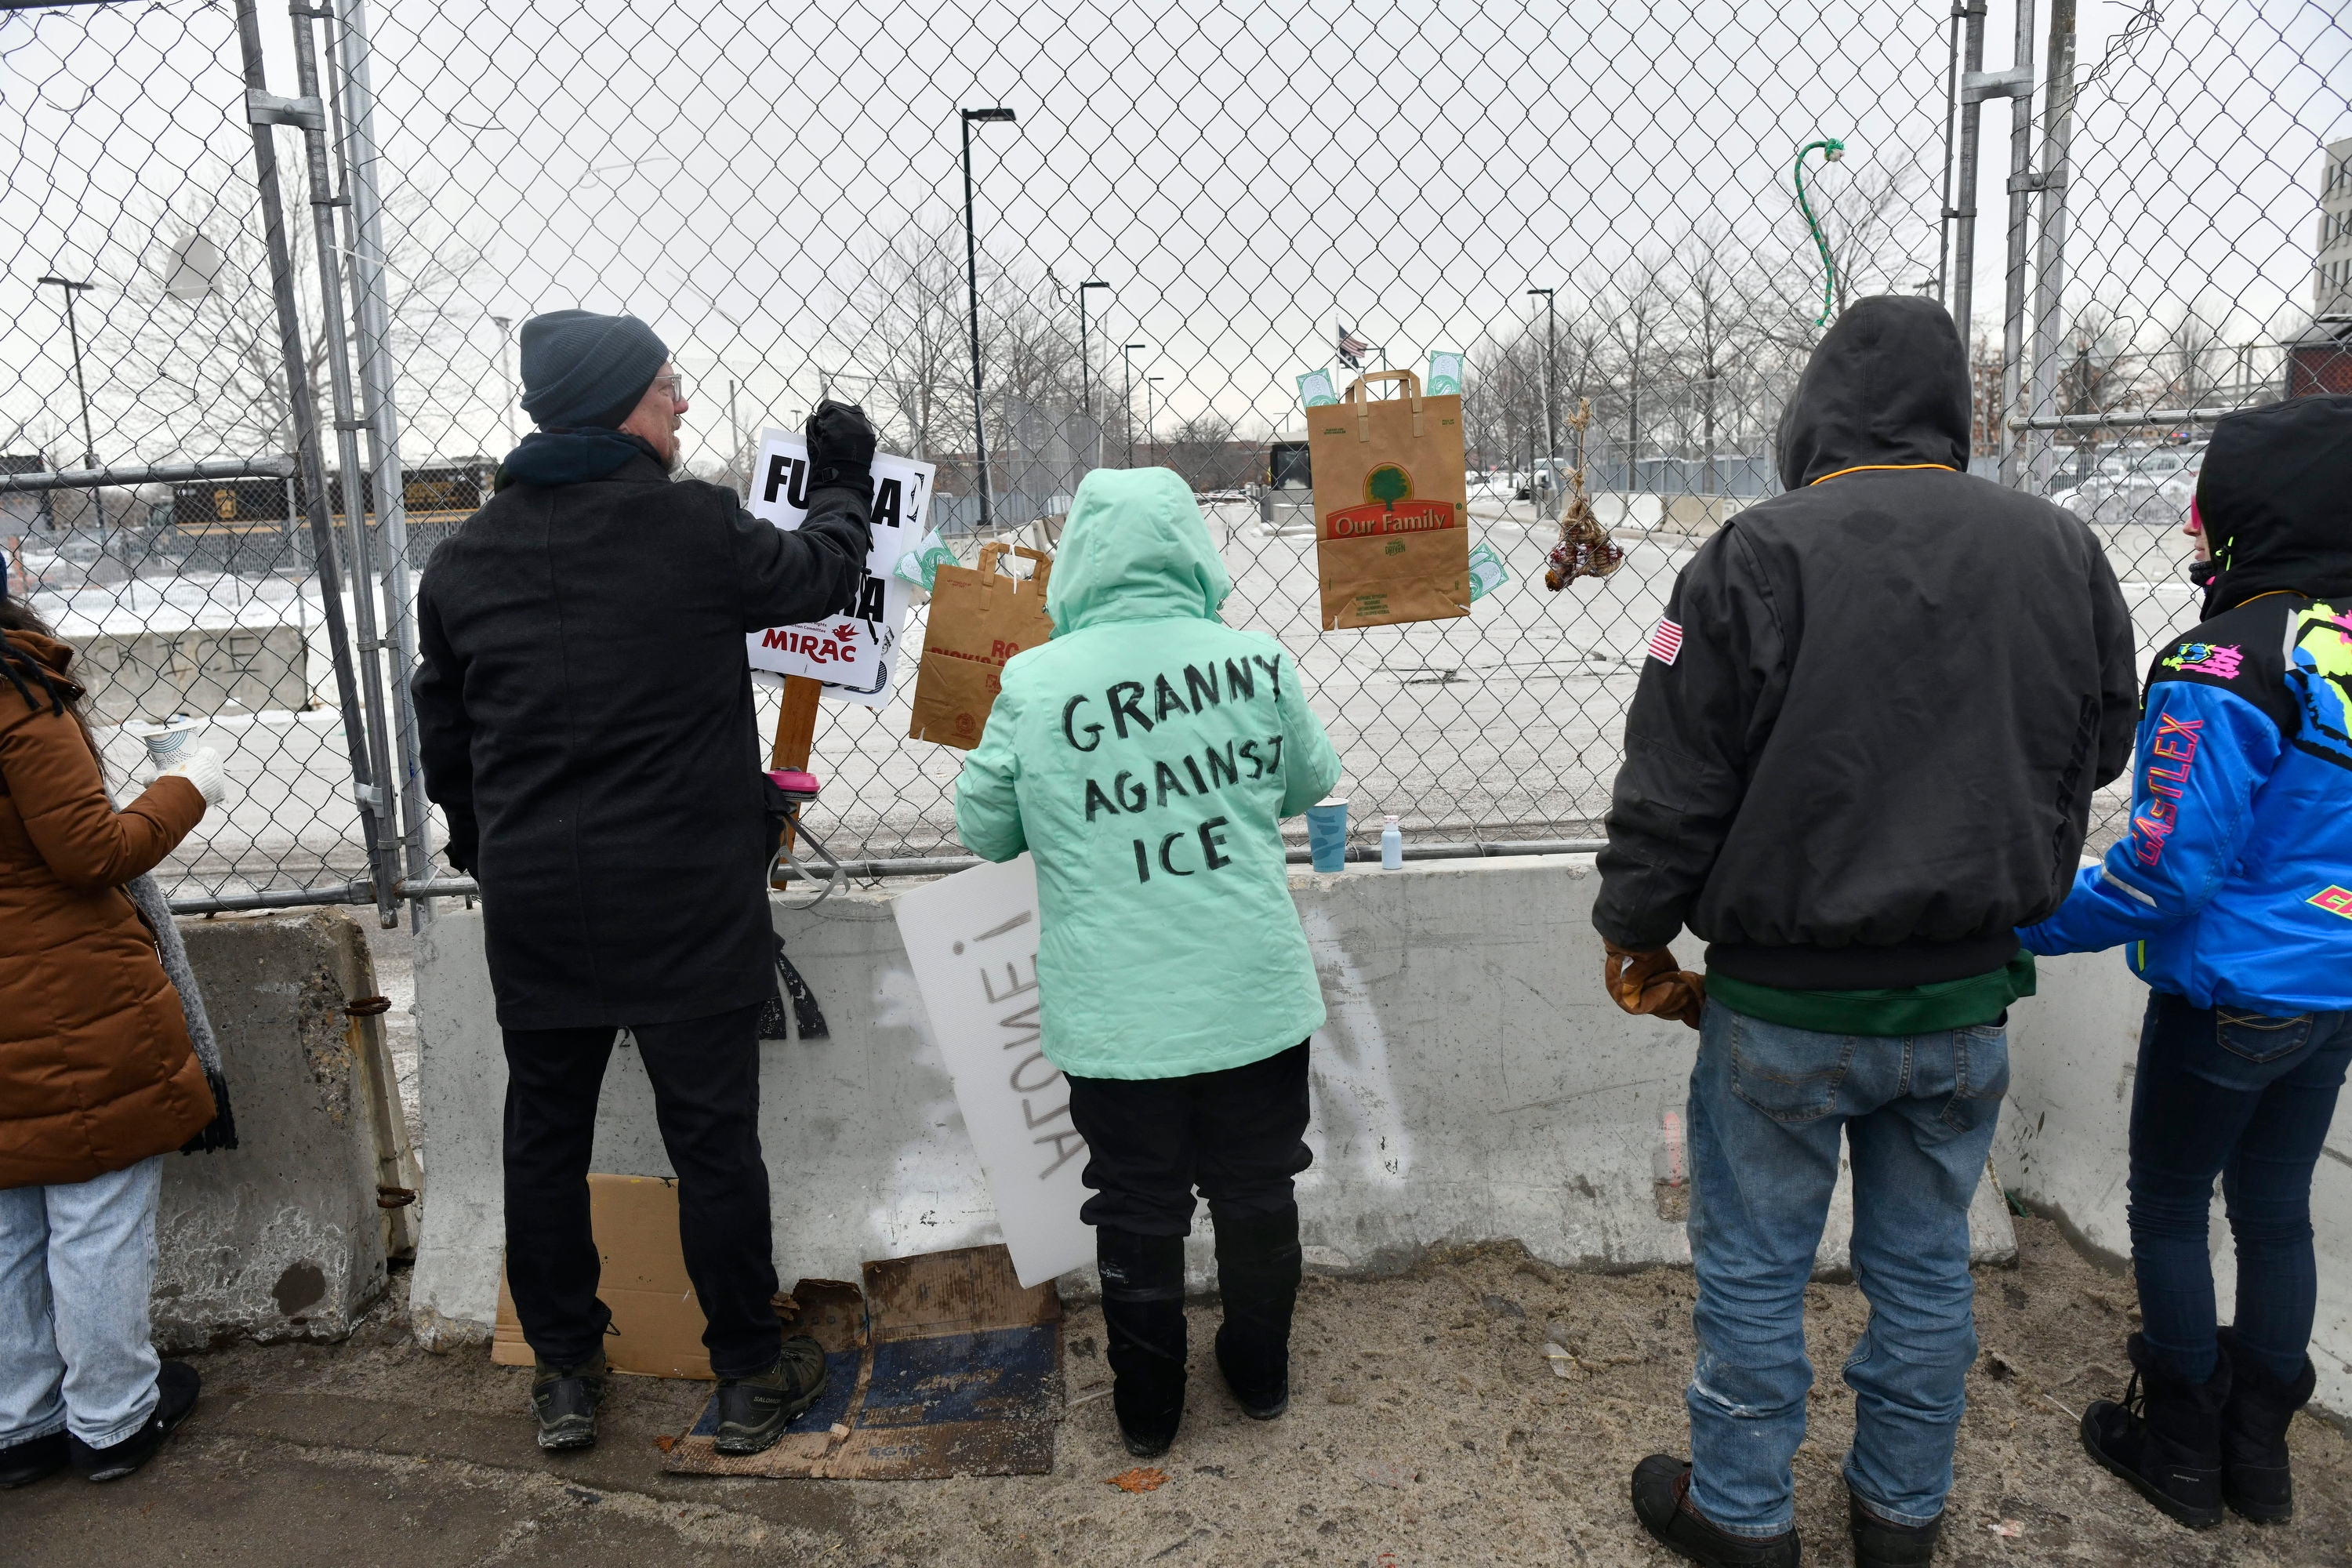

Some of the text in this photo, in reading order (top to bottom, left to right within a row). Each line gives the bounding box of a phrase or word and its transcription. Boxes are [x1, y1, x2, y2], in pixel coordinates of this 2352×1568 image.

[1335, 508, 1446, 537] Our Family
[1385, 543, 1406, 556] DRIVEN
[761, 628, 857, 664] MIRAC
[804, 625, 826, 633] Committee
[156, 636, 261, 677] ICE
[1062, 652, 1282, 753] GRANNY
[1084, 734, 1284, 822] AGAINST
[1132, 815, 1233, 884] ICE
[753, 1396, 784, 1406] SALOMON
